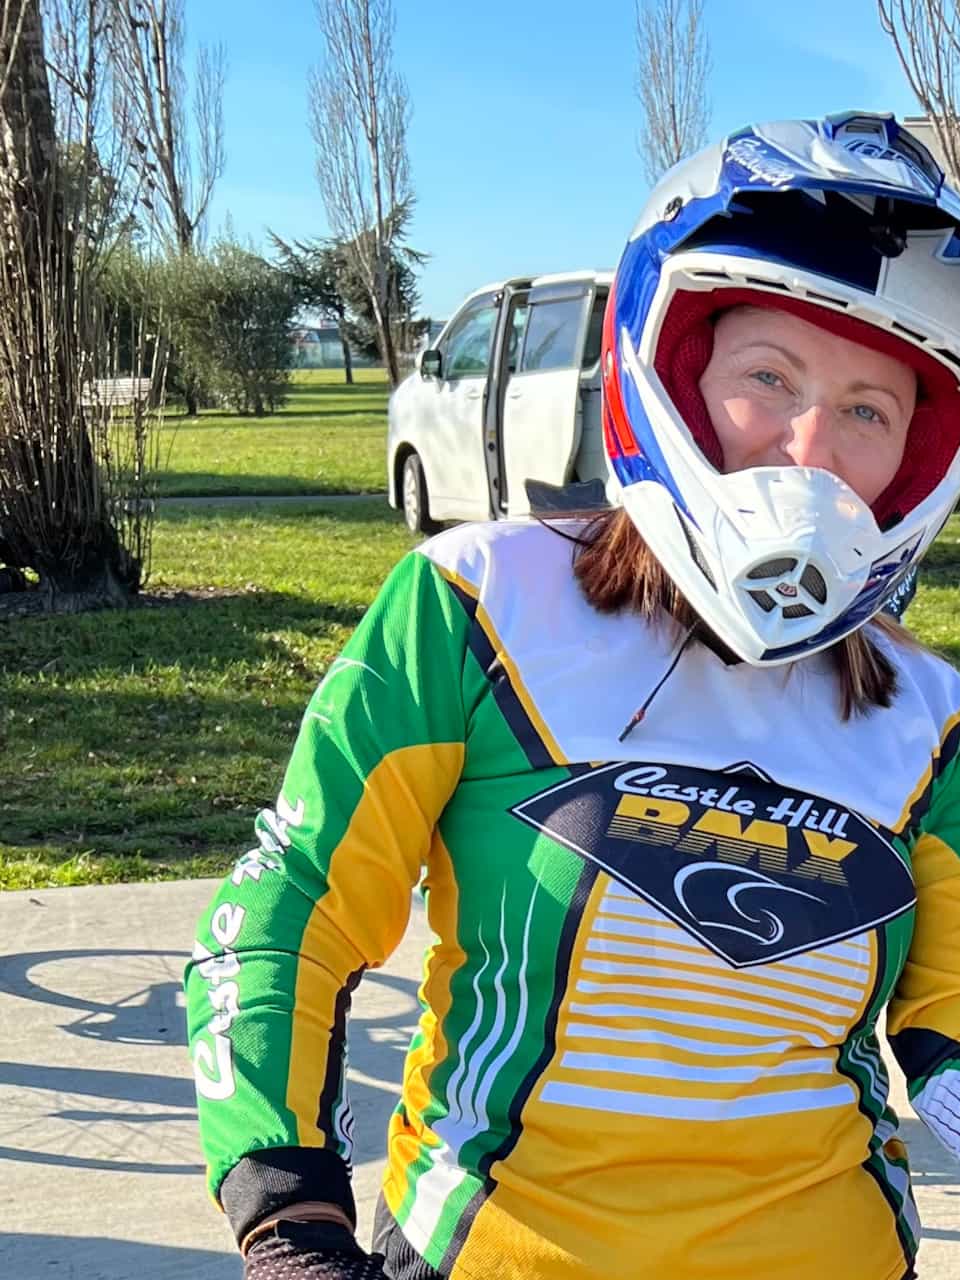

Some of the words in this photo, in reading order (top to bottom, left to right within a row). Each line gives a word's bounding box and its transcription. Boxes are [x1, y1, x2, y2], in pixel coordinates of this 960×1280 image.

[607, 793, 860, 887] BMX
[614, 766, 757, 816] Castle
[766, 798, 850, 838] Hill
